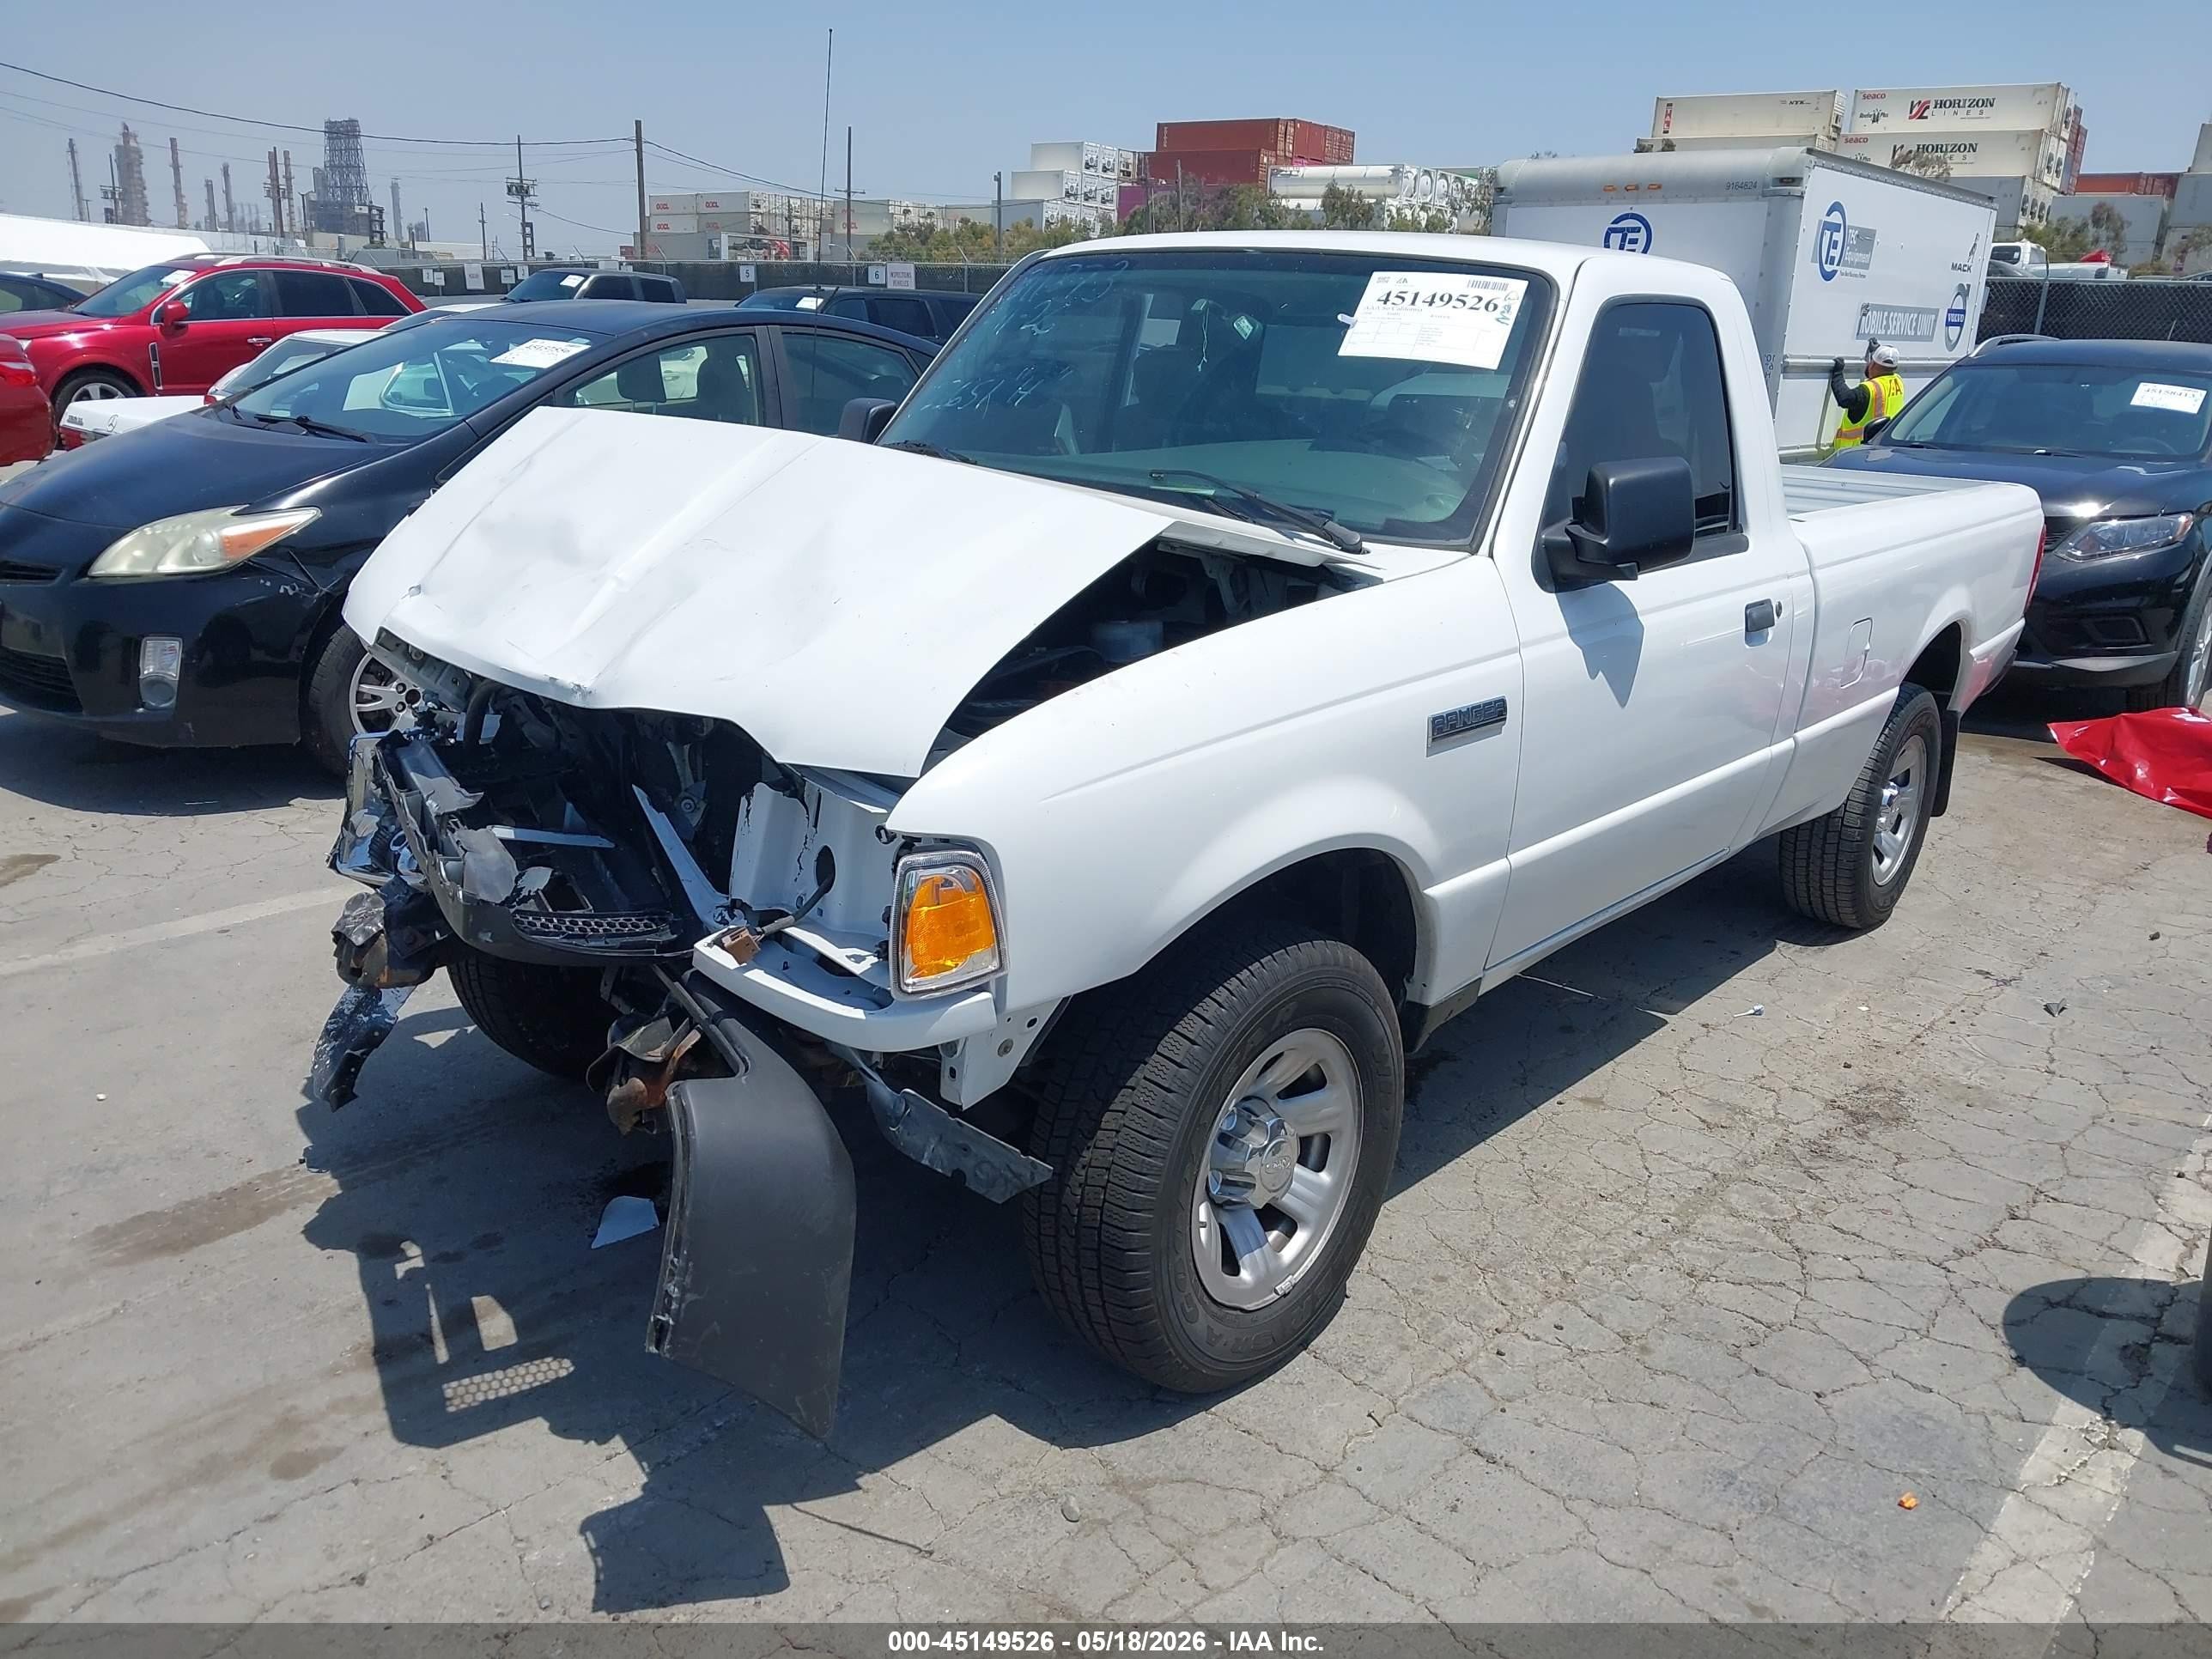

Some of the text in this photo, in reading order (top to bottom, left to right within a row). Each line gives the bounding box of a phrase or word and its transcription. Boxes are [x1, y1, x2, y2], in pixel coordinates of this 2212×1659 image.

[1932, 97, 1996, 109] HORIZON
[1916, 143, 1978, 155] HORIZON
[1950, 261, 1972, 274] MACK
[744, 270, 750, 279] 5
[874, 270, 879, 280] 6
[1377, 289, 1500, 313] 45149526
[1948, 313, 1965, 323] VOLVO
[1887, 312, 1917, 337] SERVICE
[1917, 313, 1936, 337] UNIT
[1431, 698, 1506, 737] RANGER
